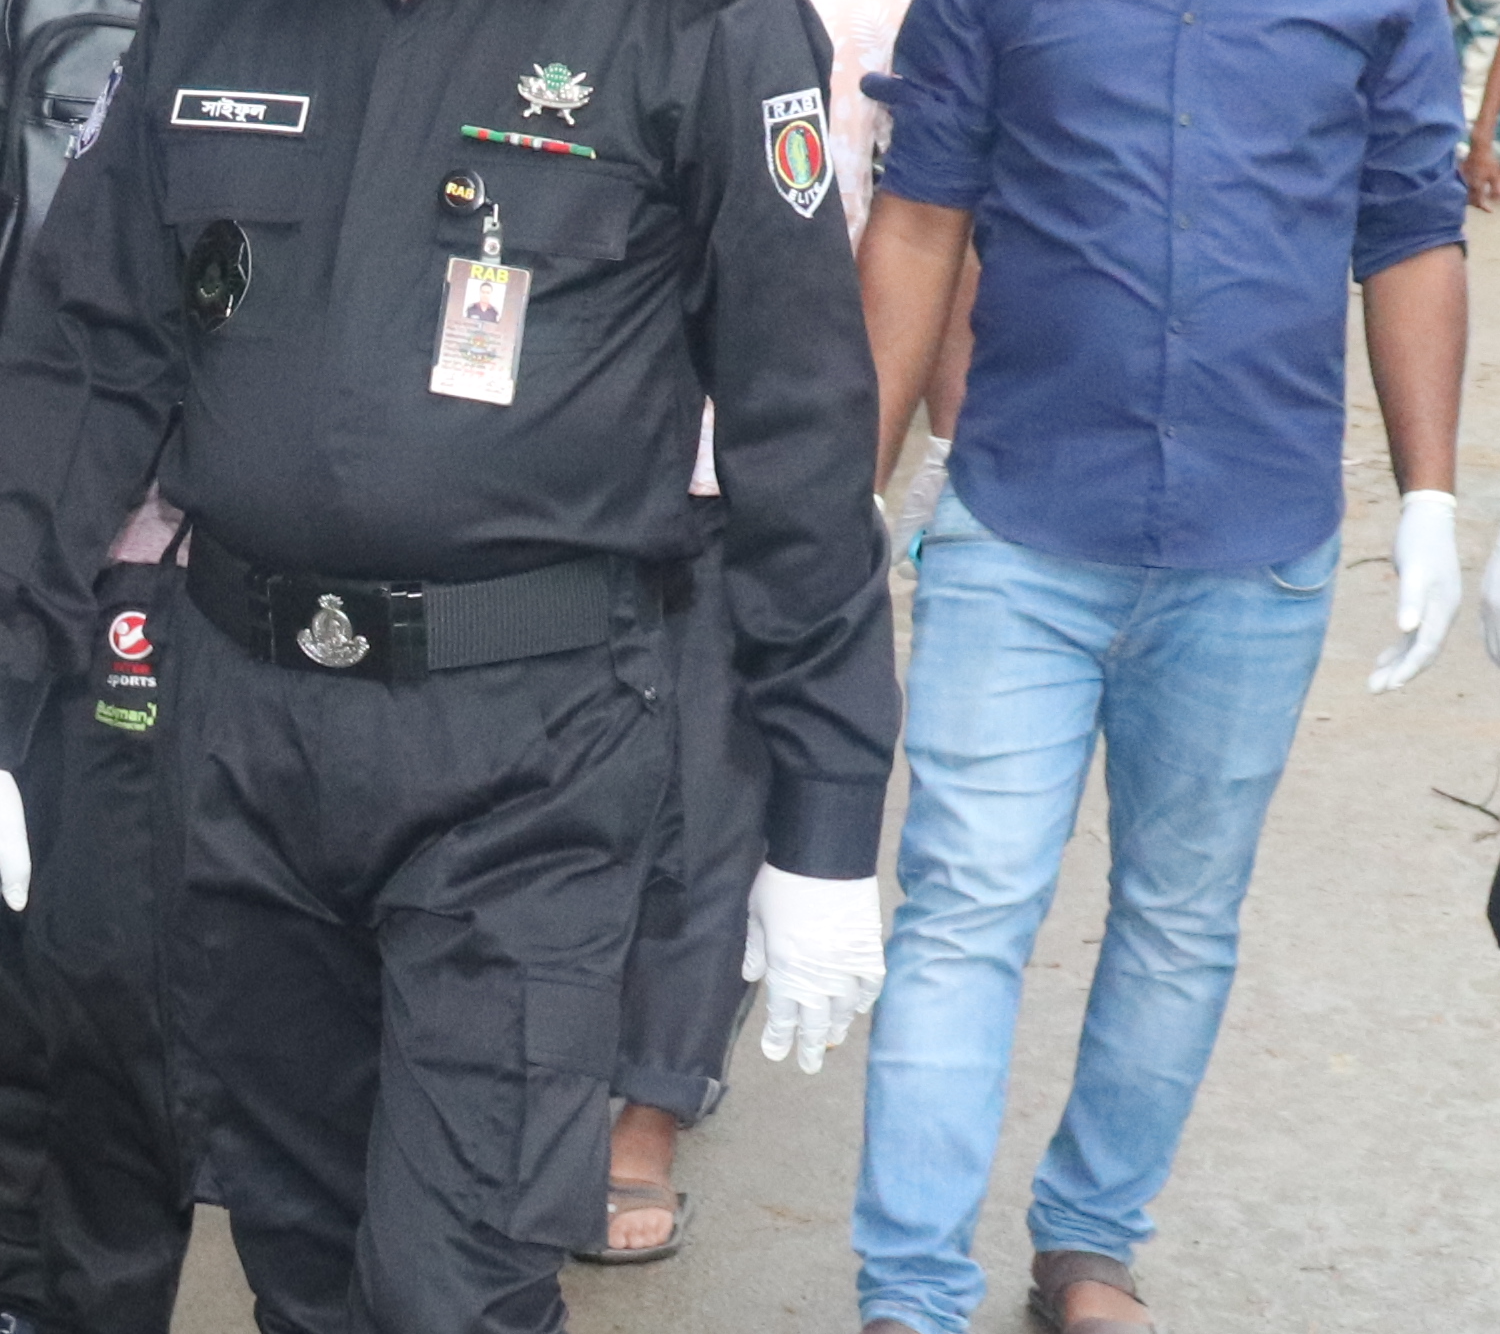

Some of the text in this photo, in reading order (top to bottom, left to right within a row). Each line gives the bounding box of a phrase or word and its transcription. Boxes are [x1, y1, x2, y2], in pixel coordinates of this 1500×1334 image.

[200, 97, 267, 123] সাইফুল
[773, 95, 815, 120] RAB
[444, 181, 476, 201] RAB
[469, 263, 510, 284] RAB
